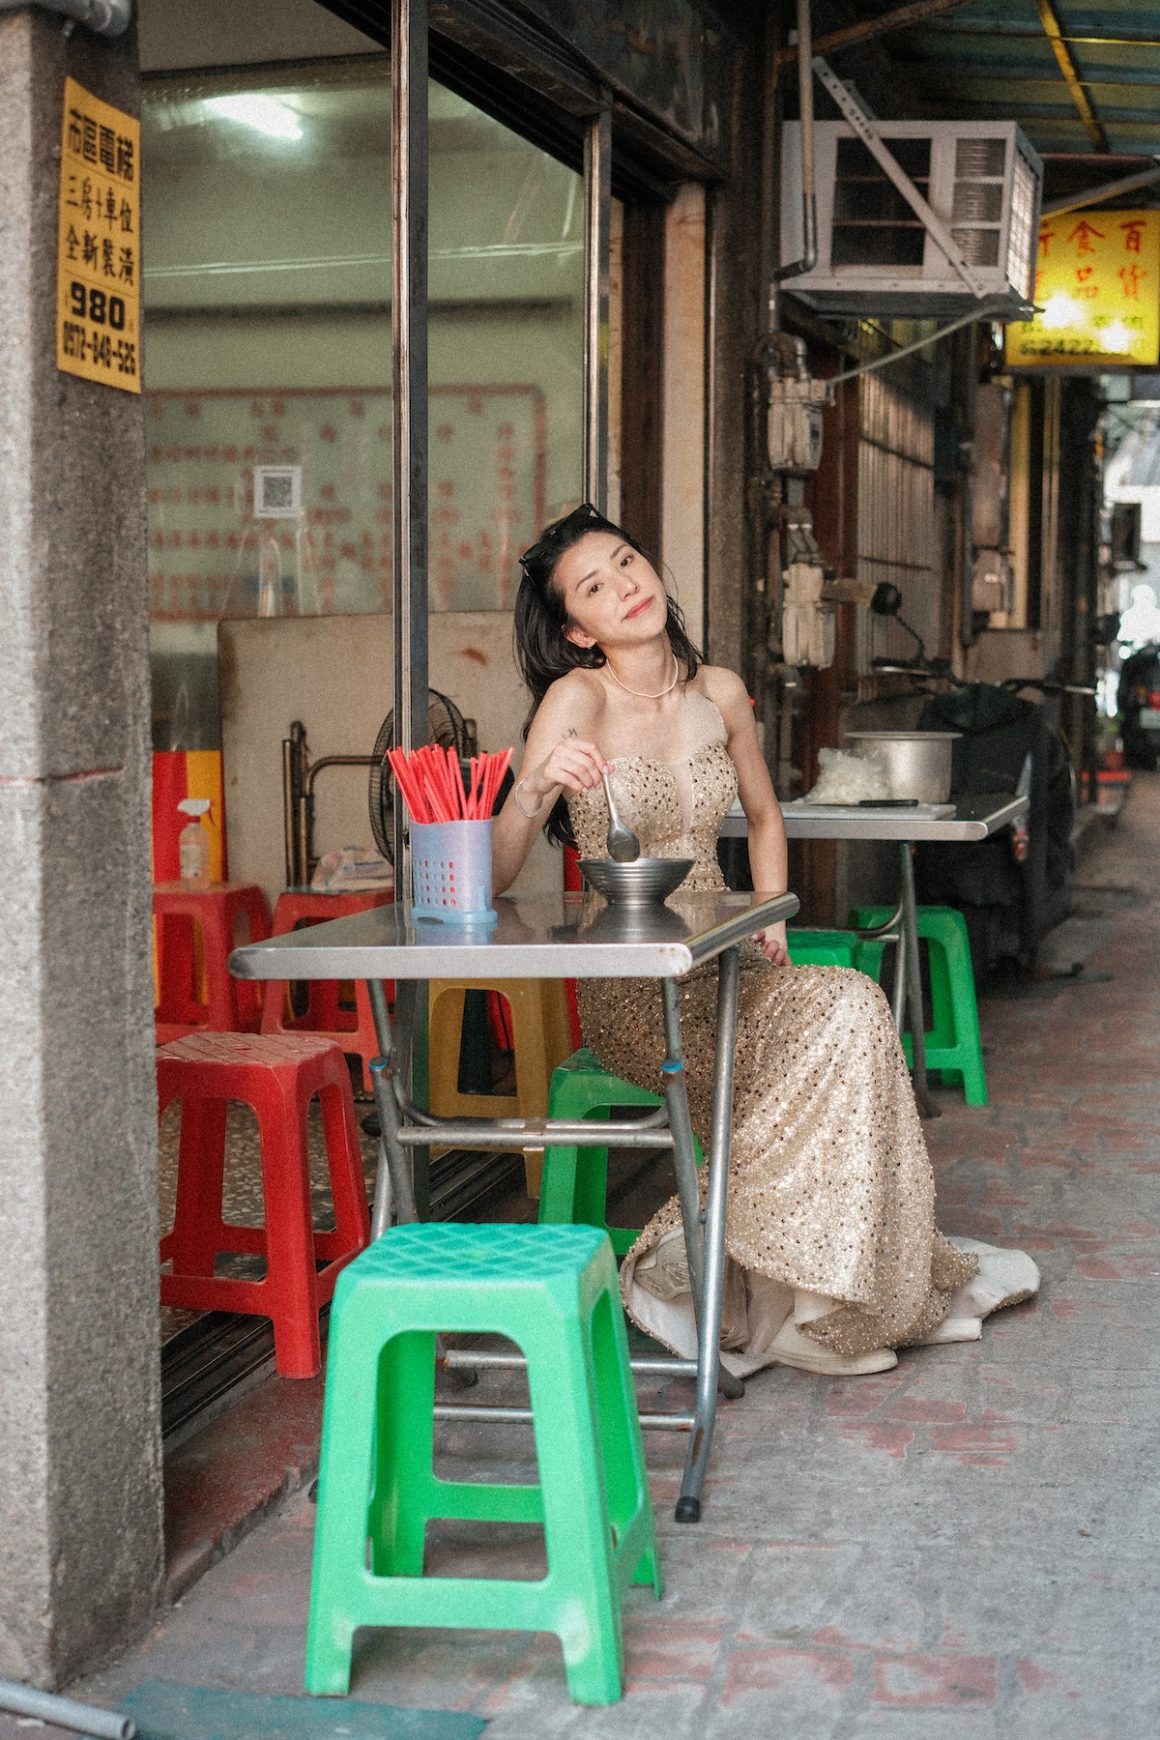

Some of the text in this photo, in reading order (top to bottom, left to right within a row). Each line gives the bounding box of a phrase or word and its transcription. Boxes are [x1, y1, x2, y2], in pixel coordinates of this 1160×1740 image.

[69, 107, 134, 181] 市區電梯
[1067, 220, 1106, 298] 食品
[1117, 220, 1148, 301] 百貨
[70, 280, 126, 332] 980
